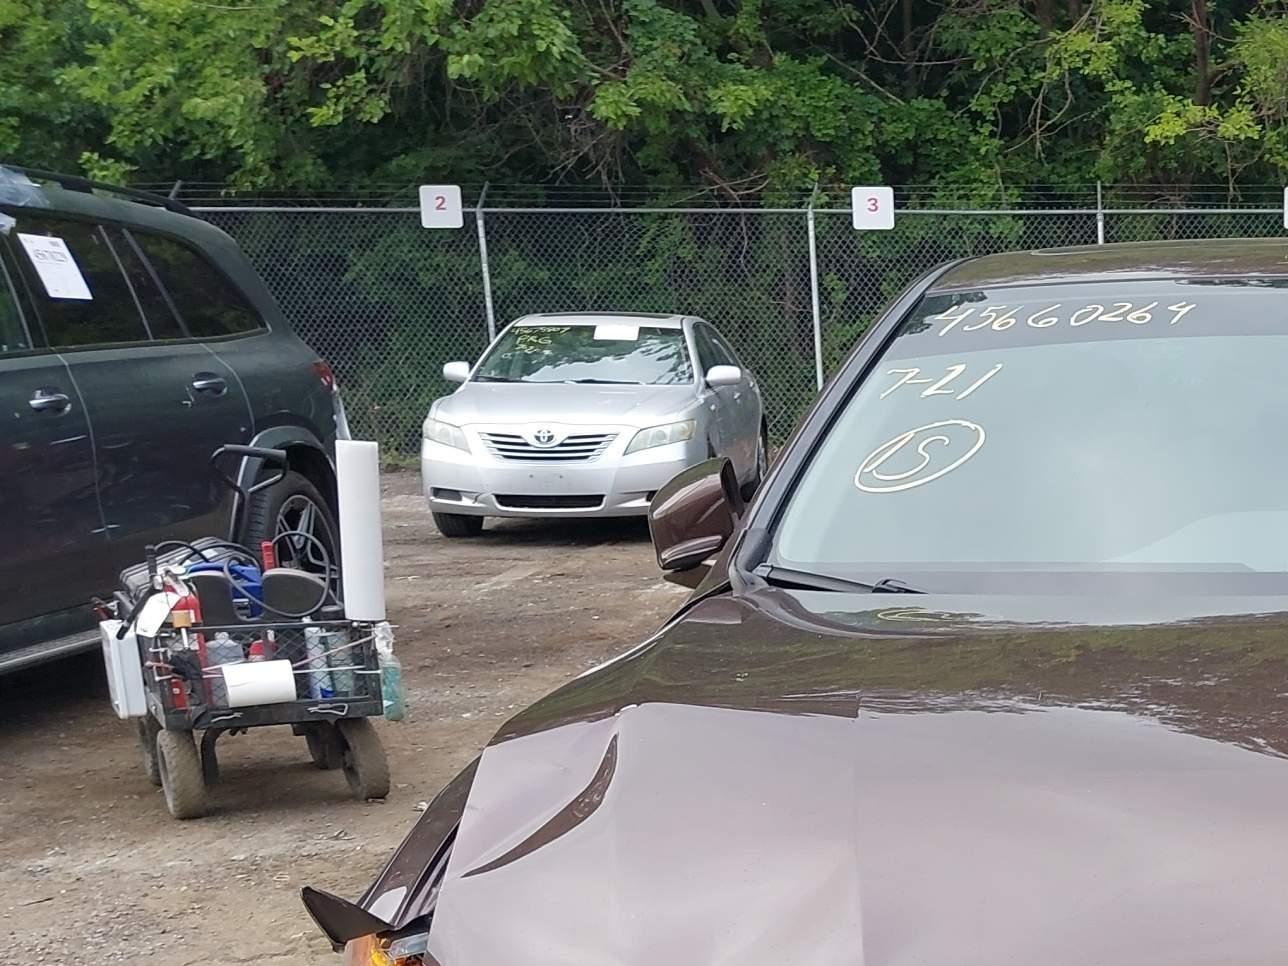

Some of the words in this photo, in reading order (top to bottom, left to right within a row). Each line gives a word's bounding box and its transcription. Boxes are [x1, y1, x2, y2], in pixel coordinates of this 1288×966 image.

[434, 195, 447, 211] 2
[866, 197, 879, 213] 3
[879, 363, 1004, 400] 7-21
